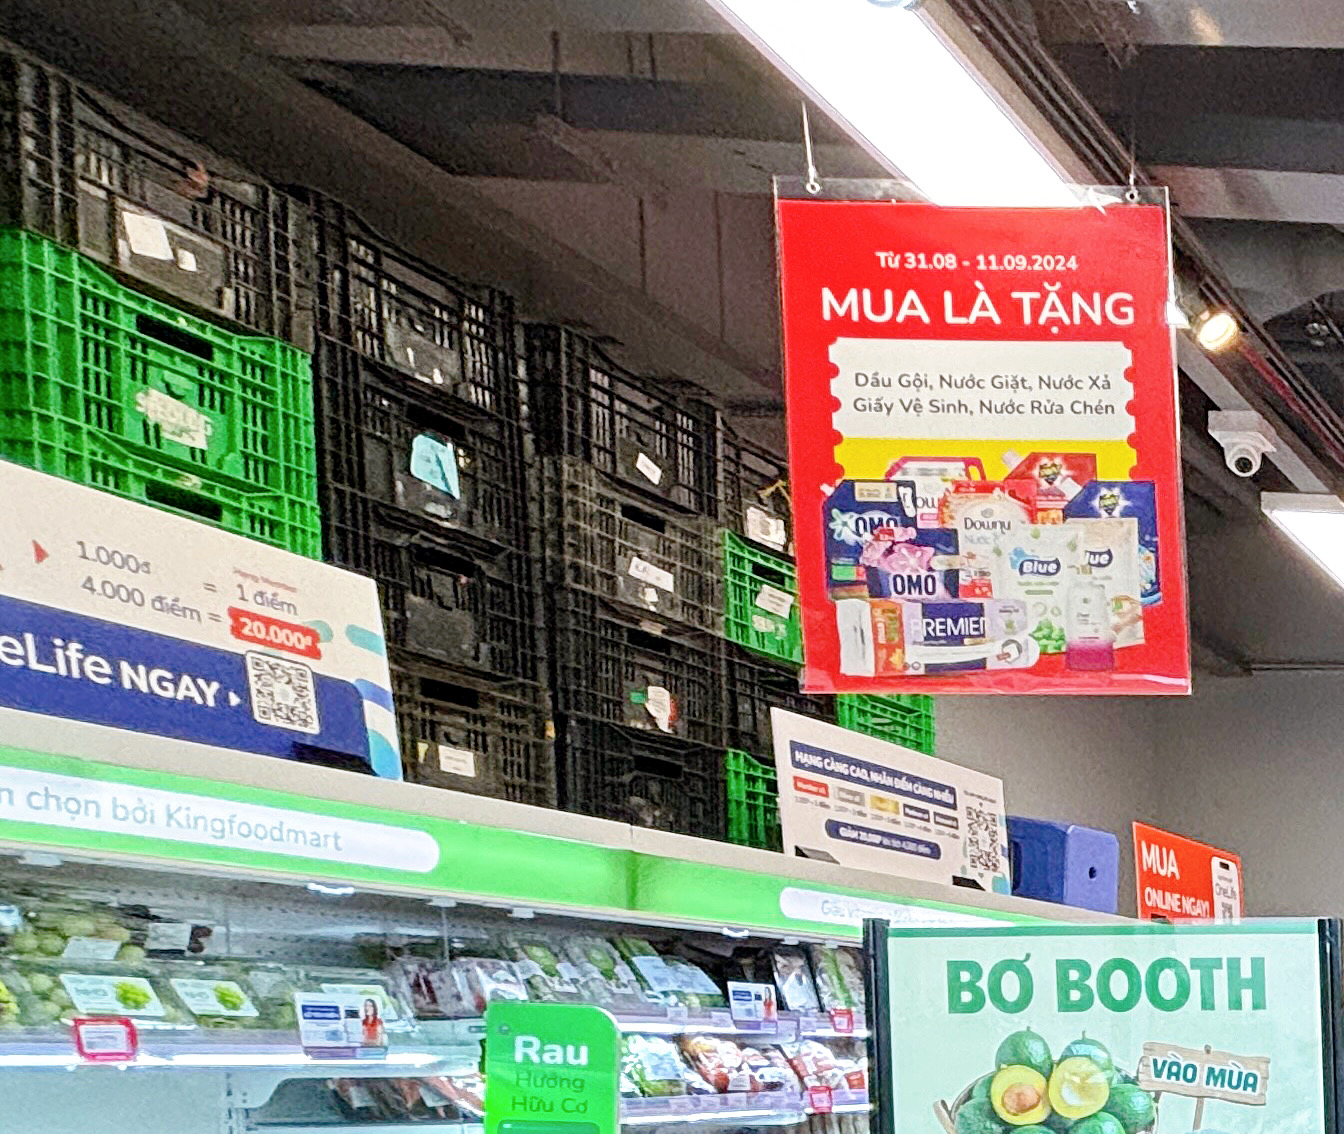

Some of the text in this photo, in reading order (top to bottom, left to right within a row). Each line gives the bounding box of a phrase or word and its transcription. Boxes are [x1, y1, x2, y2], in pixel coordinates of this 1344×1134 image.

[876, 251, 1078, 271] Từ 31.08 11.09.2024
[821, 280, 1135, 335] MUA LÀ TẶNG
[897, 372, 934, 396] Gội,
[939, 374, 985, 391] Nước
[991, 374, 1033, 394] Giặt,
[1038, 375, 1084, 391] Nước
[1089, 373, 1111, 391] Xả
[853, 397, 1115, 417] Giấy Vệ Sinh, Nước Rửa Chén
[81, 575, 146, 607] 4.000
[236, 583, 249, 602] 1
[892, 574, 936, 596] OMO
[120, 660, 220, 708] NGAY
[26, 786, 101, 821] chọn
[166, 803, 343, 852] Kingfoodmart
[1141, 840, 1180, 880] MUA
[1145, 886, 1181, 912] ONLINE
[1055, 957, 1267, 1013] BOOTH
[513, 1034, 589, 1066] Rau
[515, 1071, 585, 1093] Hướng
[1152, 1051, 1259, 1093] VÀO MÙA
[511, 1095, 588, 1115] Hữu Cơ
